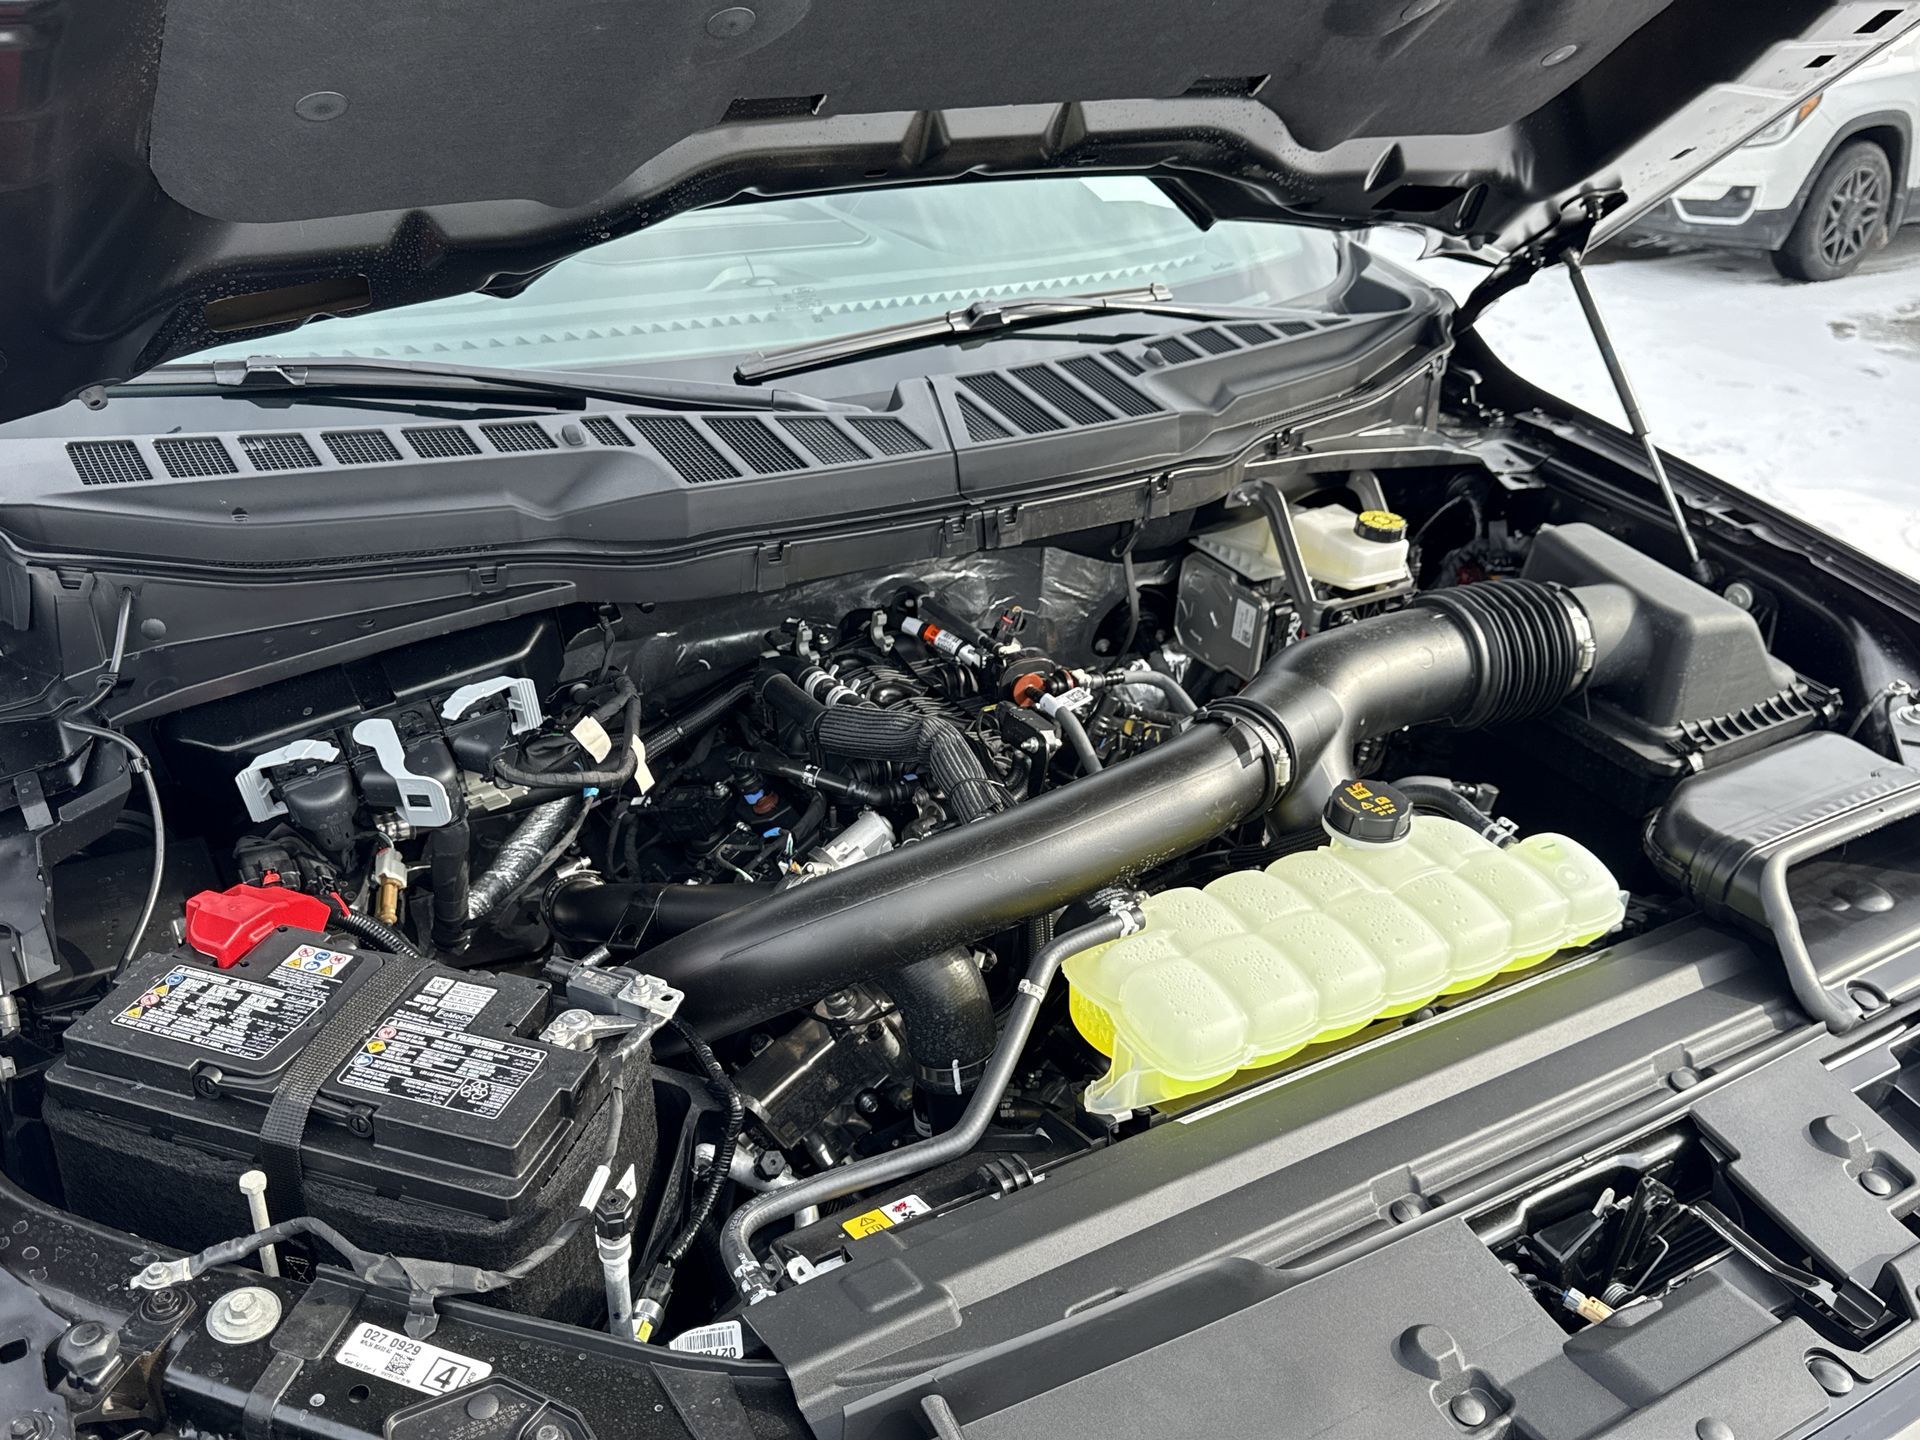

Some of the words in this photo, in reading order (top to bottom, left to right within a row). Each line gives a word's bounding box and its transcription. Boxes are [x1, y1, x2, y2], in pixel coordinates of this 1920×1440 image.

[440, 1009, 473, 1022] FoMoCo
[363, 1328, 388, 1343] 027
[389, 1337, 422, 1356] 0929
[434, 1366, 458, 1389] 4
